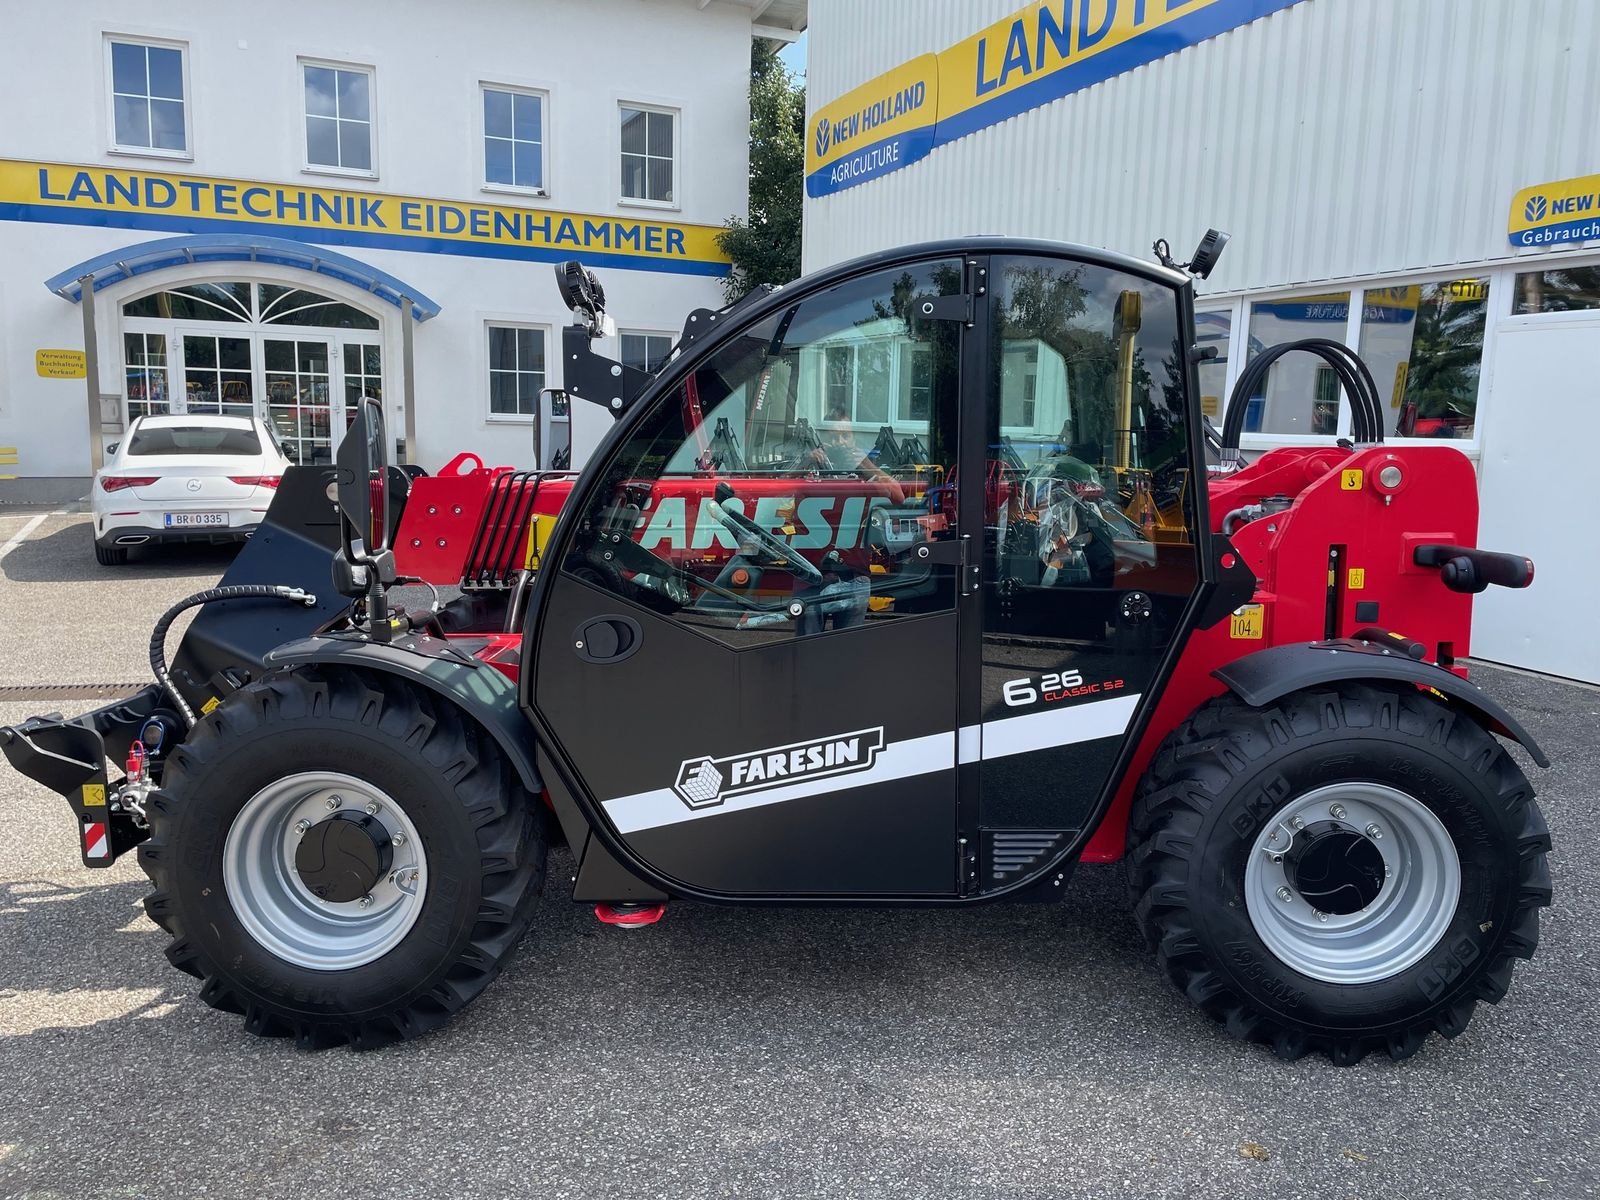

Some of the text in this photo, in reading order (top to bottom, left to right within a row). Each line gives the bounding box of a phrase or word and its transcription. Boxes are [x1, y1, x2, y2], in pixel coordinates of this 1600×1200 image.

[975, 0, 1195, 97] LAND
[832, 80, 926, 146] NEW HOLLAND
[830, 141, 899, 185] AGRICULTURE
[38, 168, 686, 255] LANDTECHNIK EIDENHAMMER
[1551, 194, 1594, 215] NEW
[39, 360, 84, 369] Buchhaltung
[41, 352, 82, 361] Verwaltung
[176, 514, 189, 524] BR
[1232, 618, 1252, 636] 104
[1002, 669, 1083, 707] 6 26
[1044, 683, 1100, 702] CLASSIC
[730, 737, 860, 786] FARESIN
[1231, 777, 1289, 837] BKT
[1418, 938, 1480, 1000] BKT
